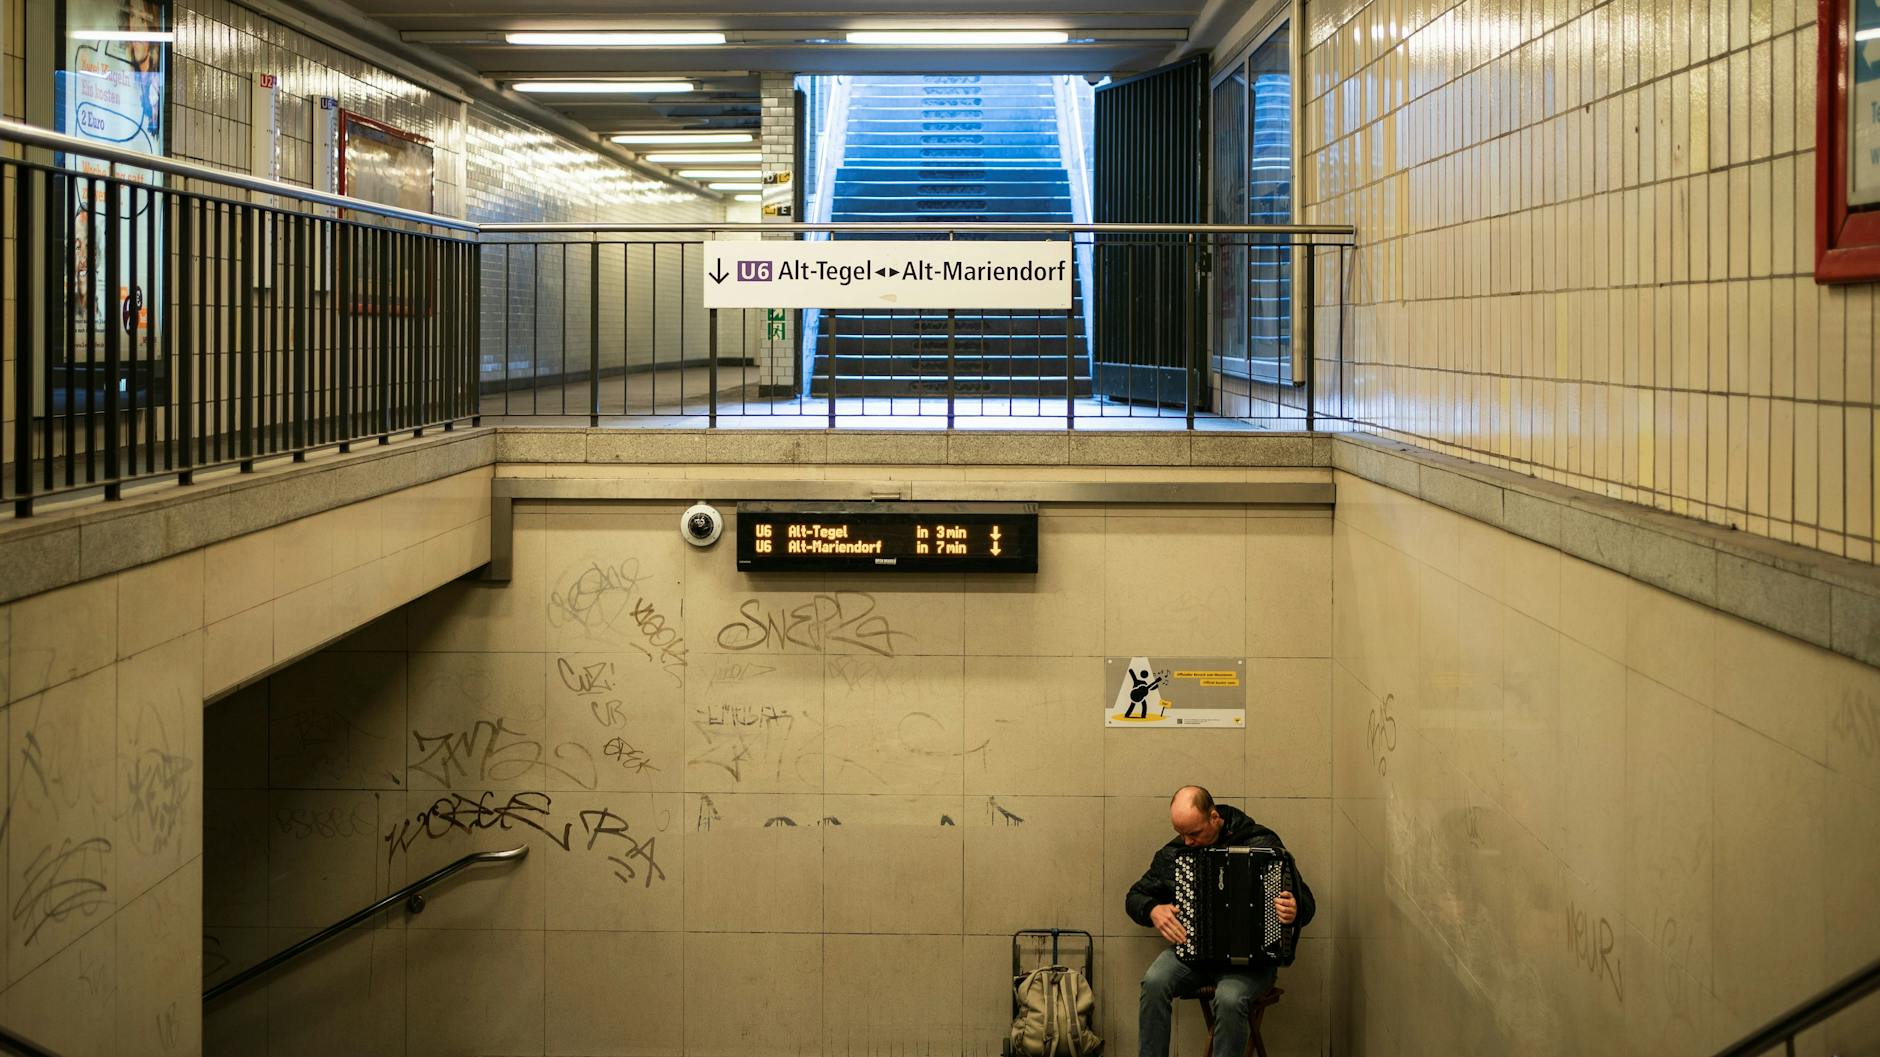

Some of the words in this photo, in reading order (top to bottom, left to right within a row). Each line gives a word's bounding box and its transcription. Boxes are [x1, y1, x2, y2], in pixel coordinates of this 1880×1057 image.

[261, 75, 272, 88] U2
[81, 110, 87, 126] 2
[88, 111, 105, 131] Euro
[741, 262, 770, 280] U6
[778, 259, 872, 286] Alt-Tegel
[902, 260, 1066, 281] Alt-Mariendorf
[755, 524, 772, 537] U6
[788, 524, 848, 539] Alt-Tegel
[917, 525, 928, 539] in
[755, 540, 772, 553] U6
[788, 540, 882, 554] Alt-Mariendorf
[917, 541, 928, 554] in
